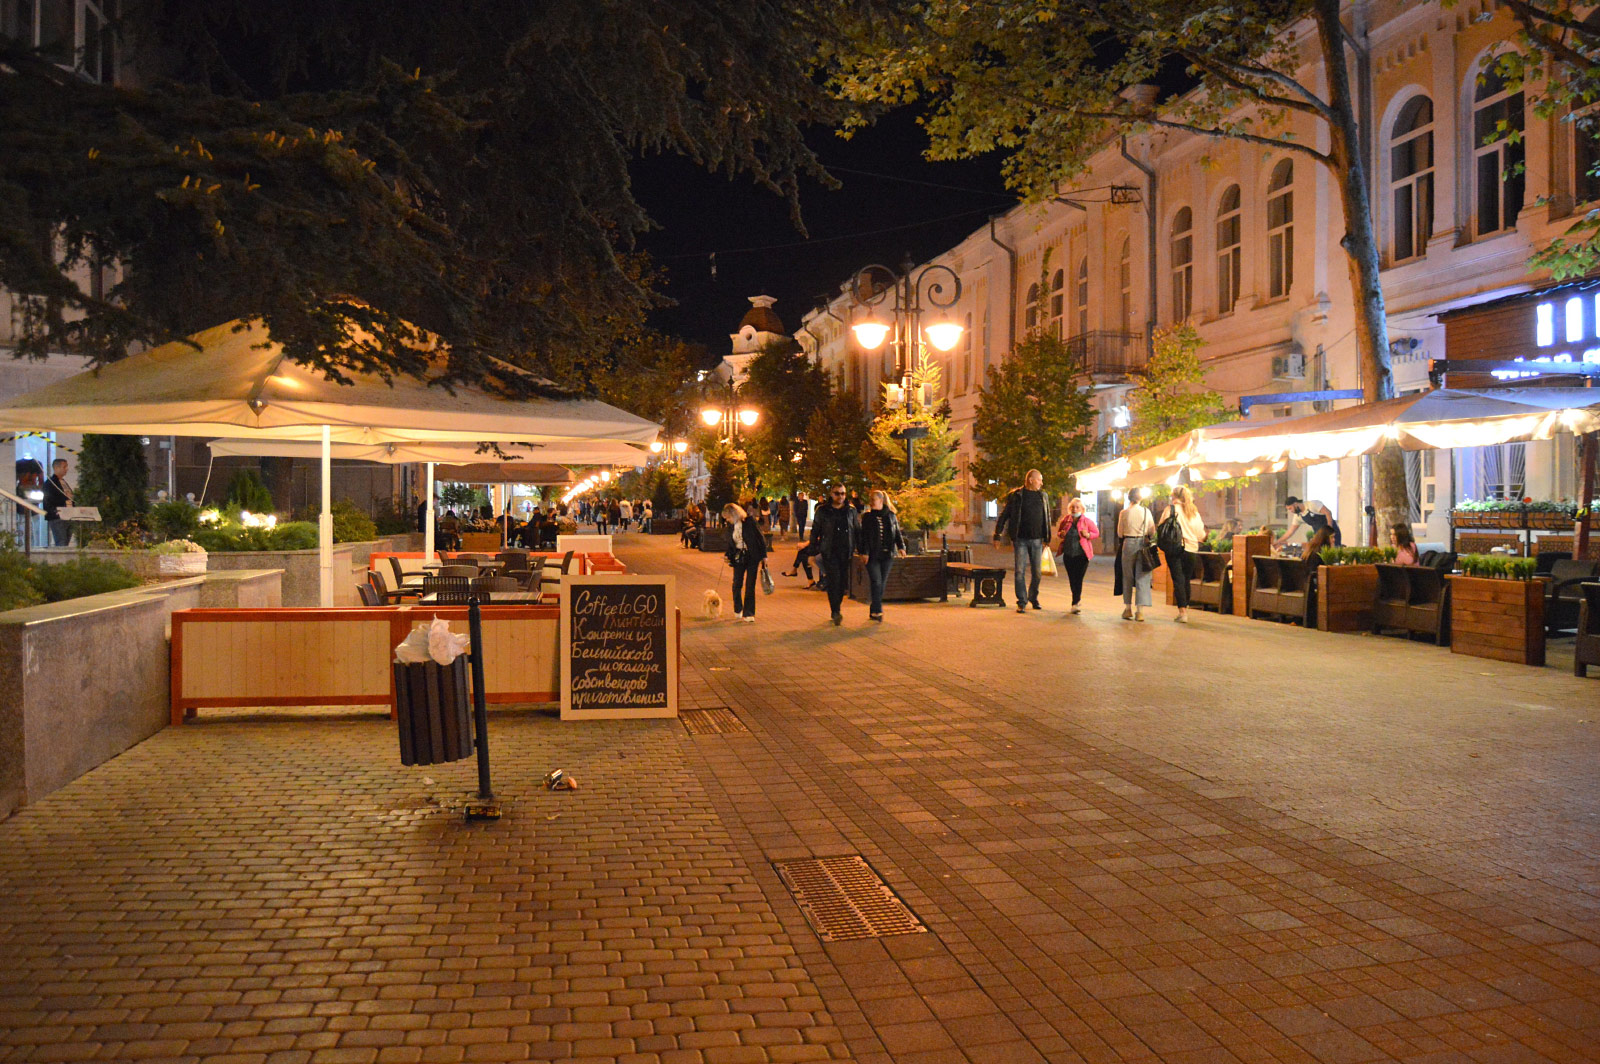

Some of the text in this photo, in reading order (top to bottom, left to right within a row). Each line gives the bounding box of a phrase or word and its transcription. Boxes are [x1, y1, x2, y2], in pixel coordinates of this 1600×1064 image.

[575, 590, 658, 616] Coffee to GO
[573, 616, 653, 650] Конфеты из
[571, 668, 648, 691] собственного
[599, 661, 661, 680] шоколада
[572, 690, 665, 708] приготовления
